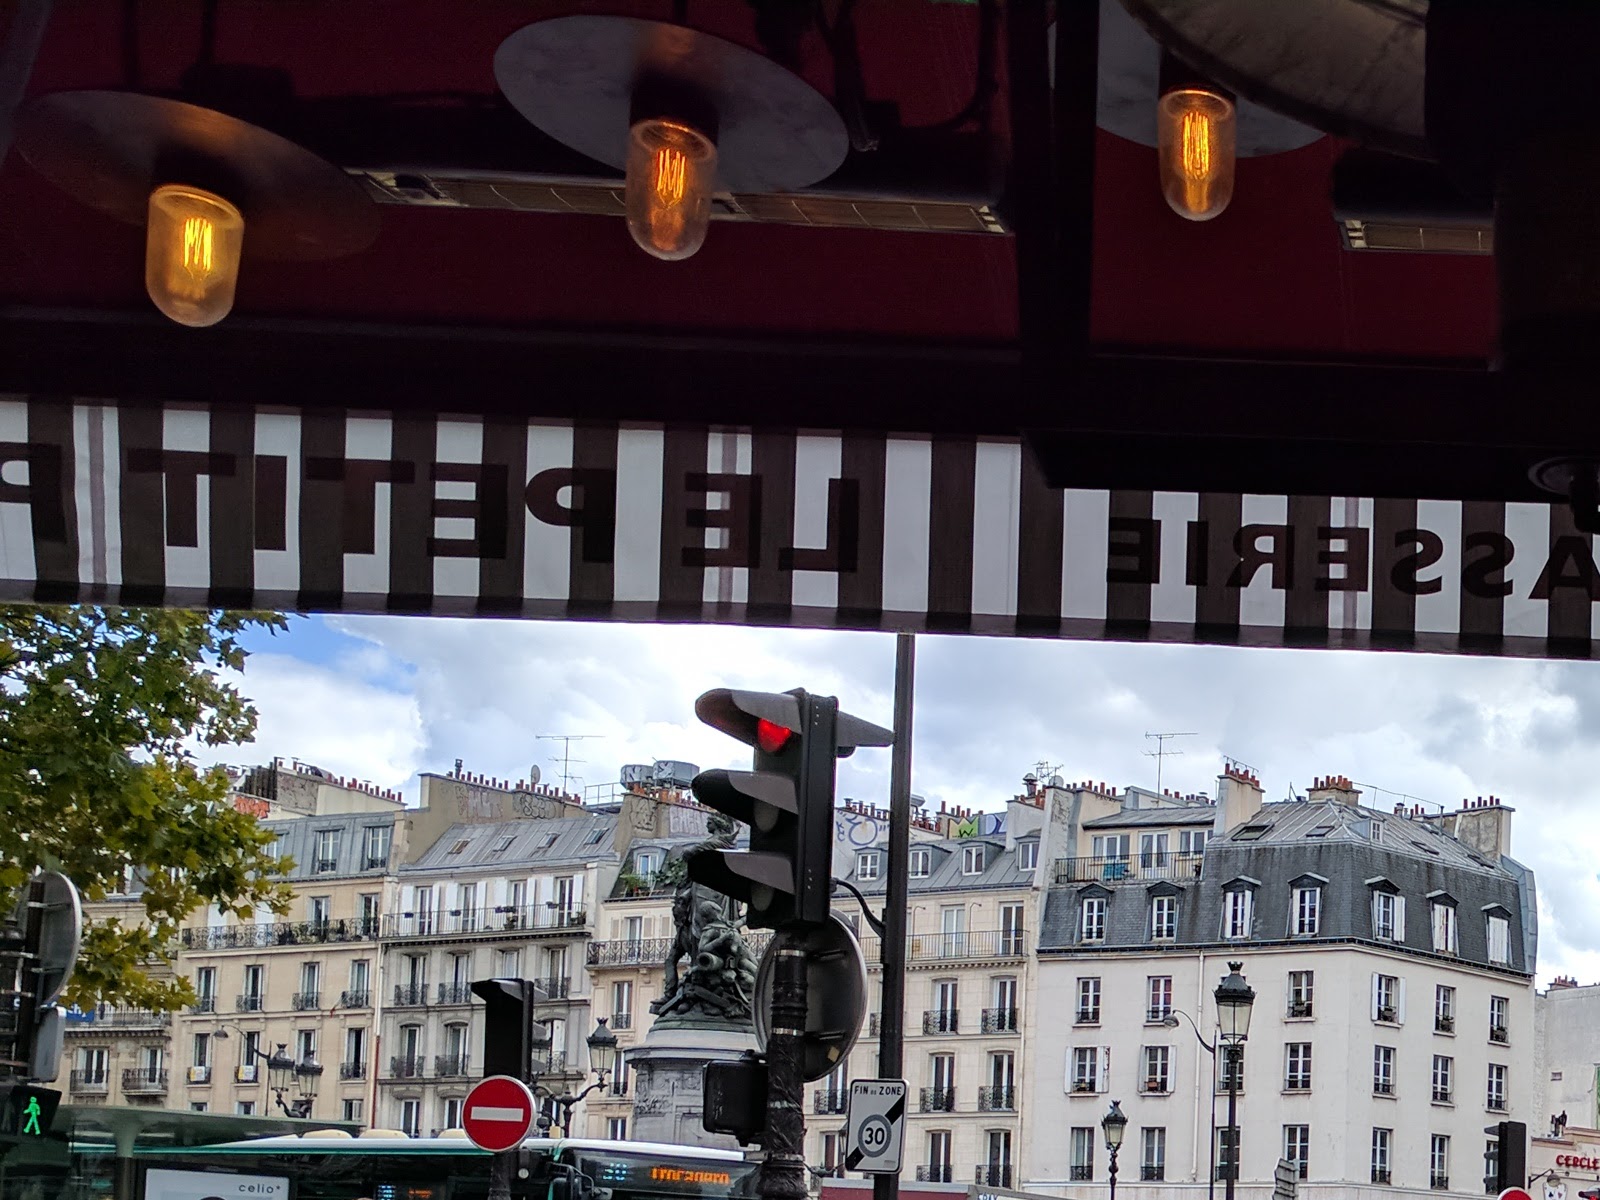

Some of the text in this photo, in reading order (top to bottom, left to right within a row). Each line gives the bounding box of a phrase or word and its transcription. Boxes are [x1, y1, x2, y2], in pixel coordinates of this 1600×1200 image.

[854, 1085, 869, 1095] FIN
[878, 1085, 902, 1095] ZONE
[864, 1127, 885, 1145] 30
[1556, 1154, 1600, 1170] CERCLE
